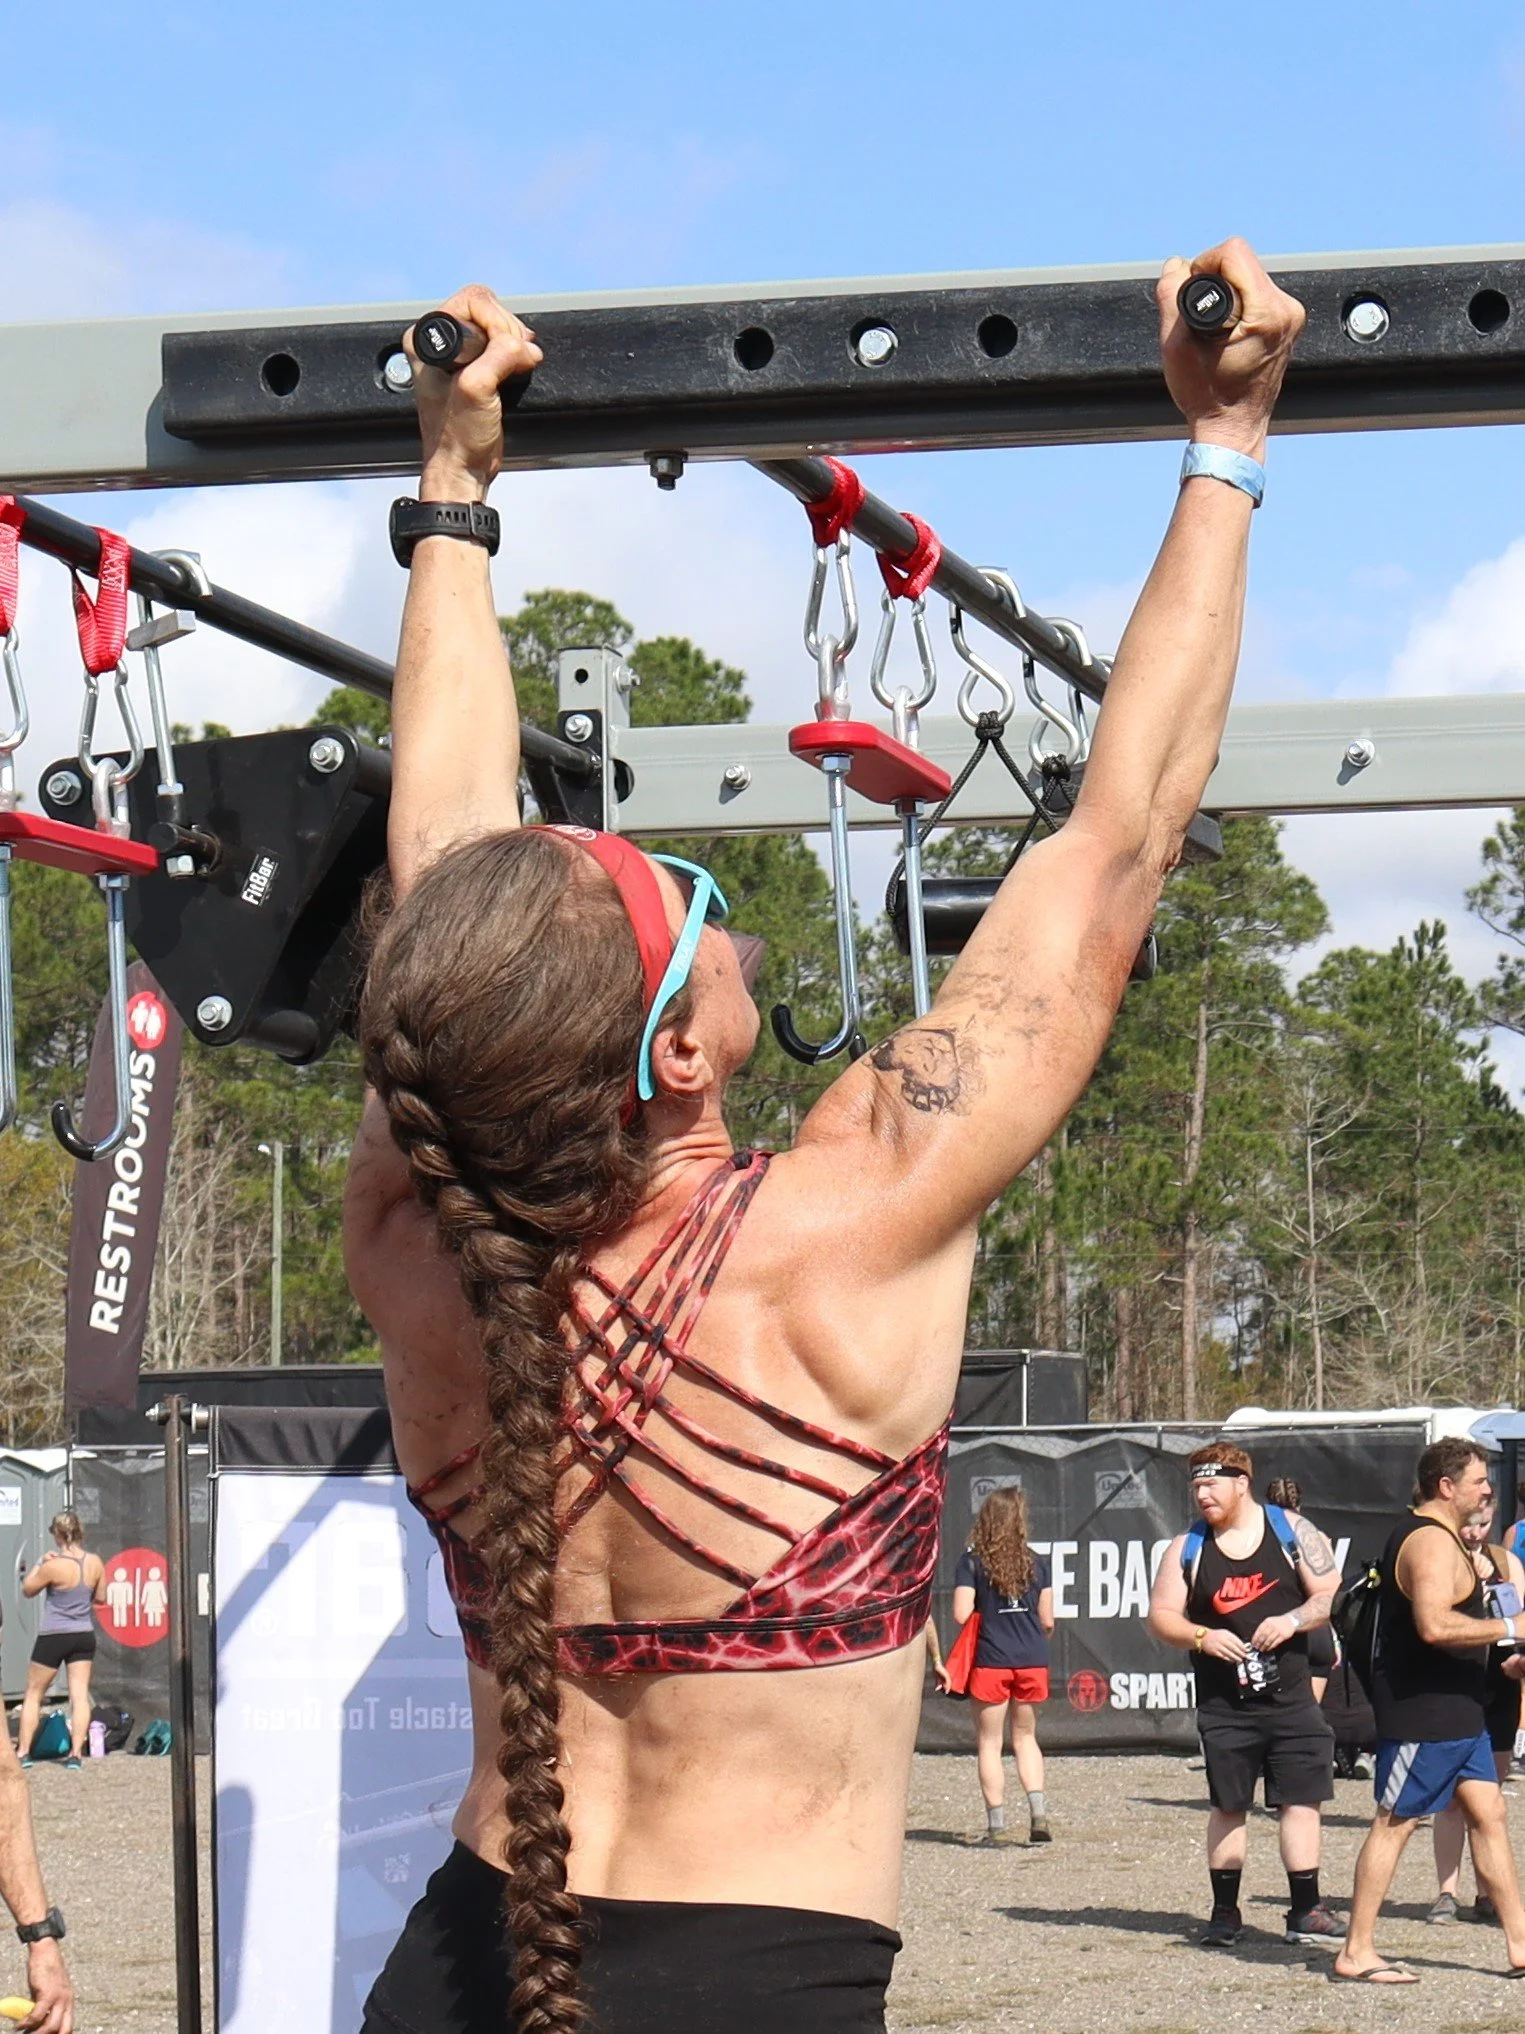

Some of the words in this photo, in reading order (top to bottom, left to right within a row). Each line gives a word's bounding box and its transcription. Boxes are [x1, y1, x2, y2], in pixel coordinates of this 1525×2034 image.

[241, 857, 274, 905] FitBar
[89, 1050, 156, 1335] RESTROOMS
[1220, 1572, 1263, 1598] NIKE
